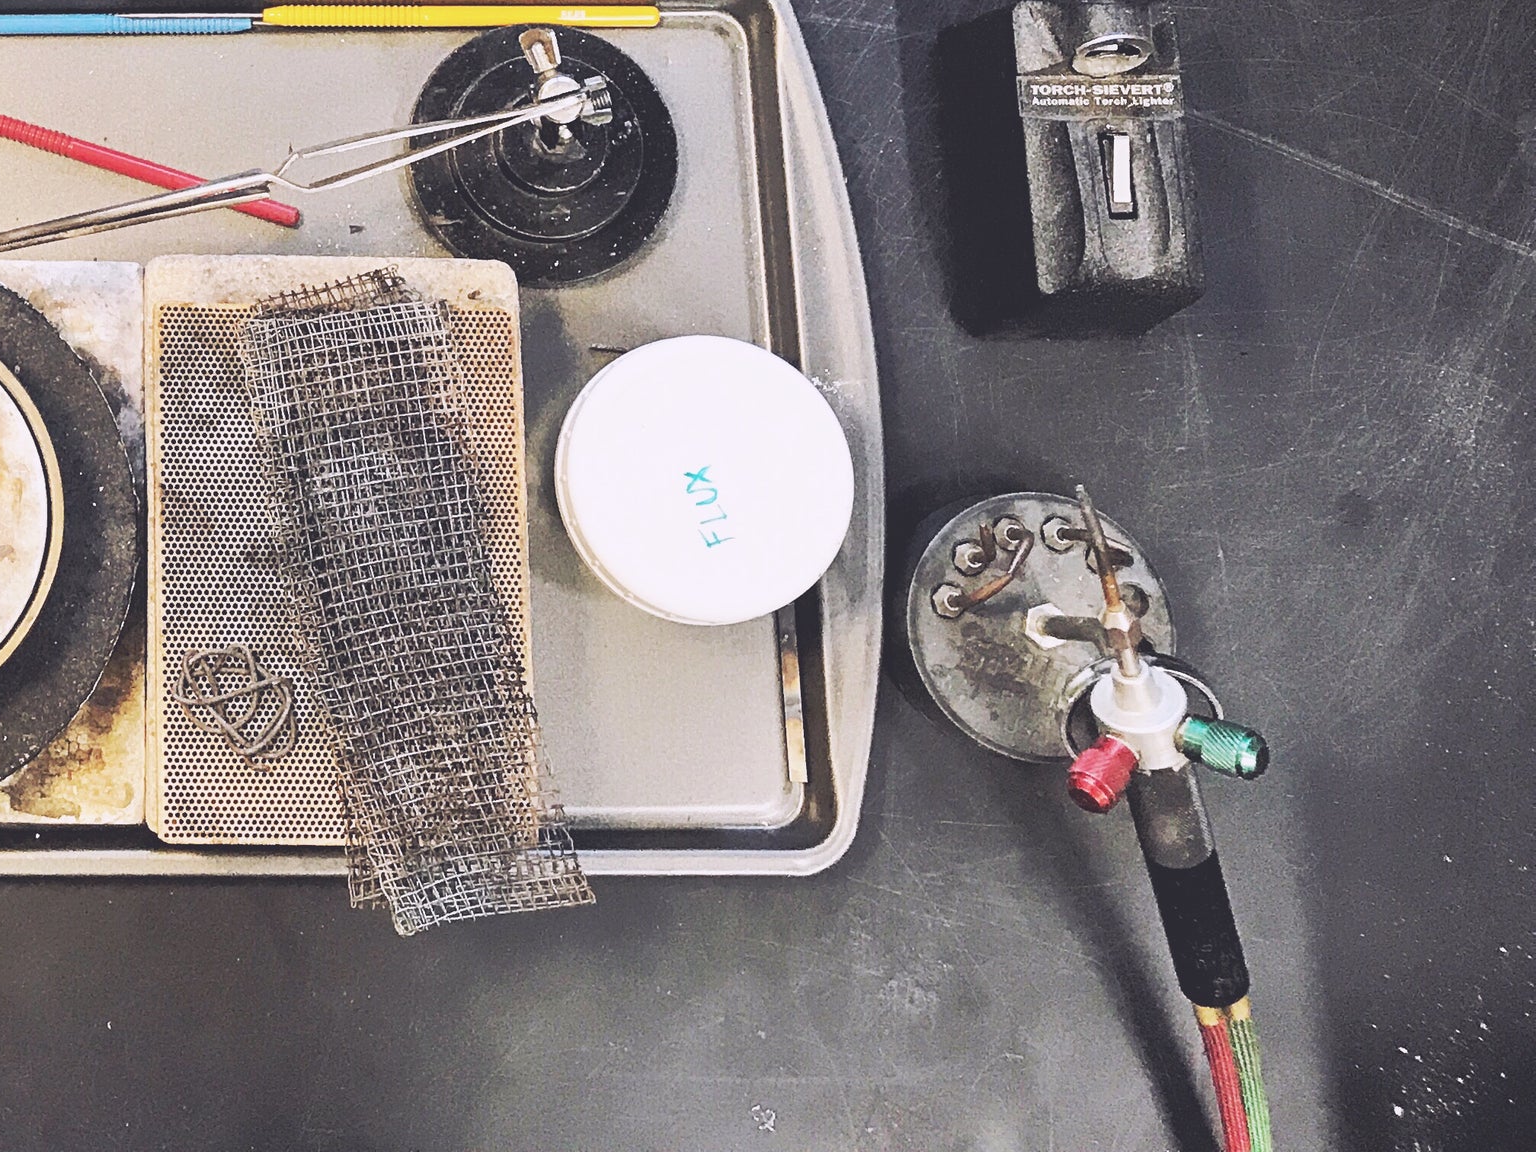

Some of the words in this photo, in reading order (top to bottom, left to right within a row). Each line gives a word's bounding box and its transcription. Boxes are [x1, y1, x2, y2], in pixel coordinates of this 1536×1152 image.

[1032, 97, 1090, 106] Automatic
[1094, 97, 1128, 106] Torch
[1132, 97, 1175, 107] Lighter
[683, 464, 736, 549] FLUX
